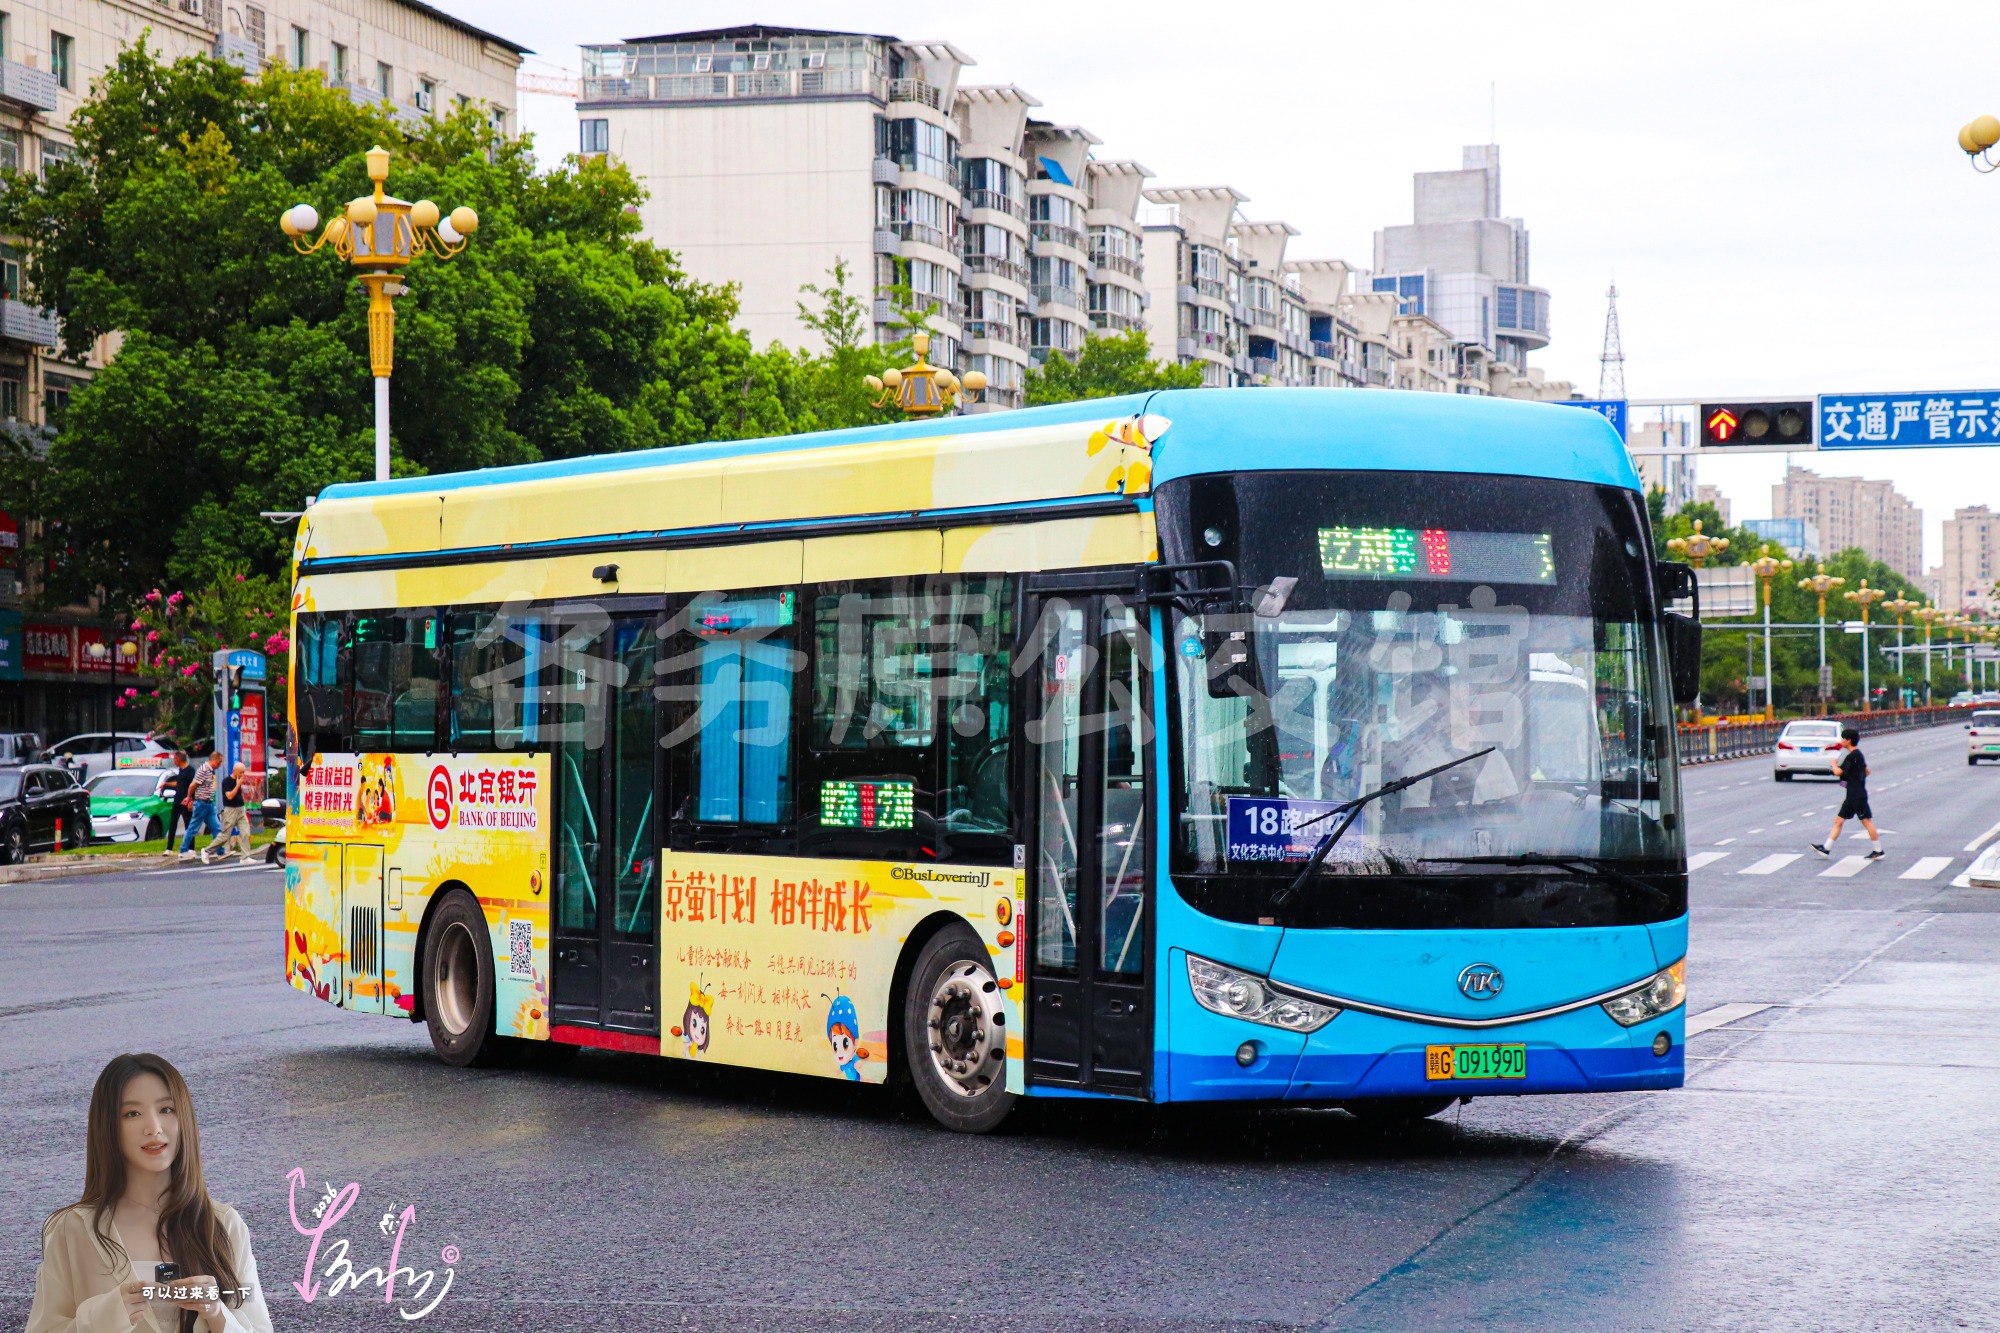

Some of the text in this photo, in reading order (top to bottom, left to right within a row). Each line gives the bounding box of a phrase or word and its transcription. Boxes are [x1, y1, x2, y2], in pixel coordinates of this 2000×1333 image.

[305, 766, 353, 786] 家庭权益日
[459, 767, 537, 807] 北京银行
[304, 791, 353, 812] 悦享好时光
[459, 811, 537, 828] BANK OF BEIJING
[1231, 843, 1285, 862] 文化艺术中心
[665, 869, 873, 935] 京萤计划 相伴成长
[771, 985, 812, 1010] 相伴成长
